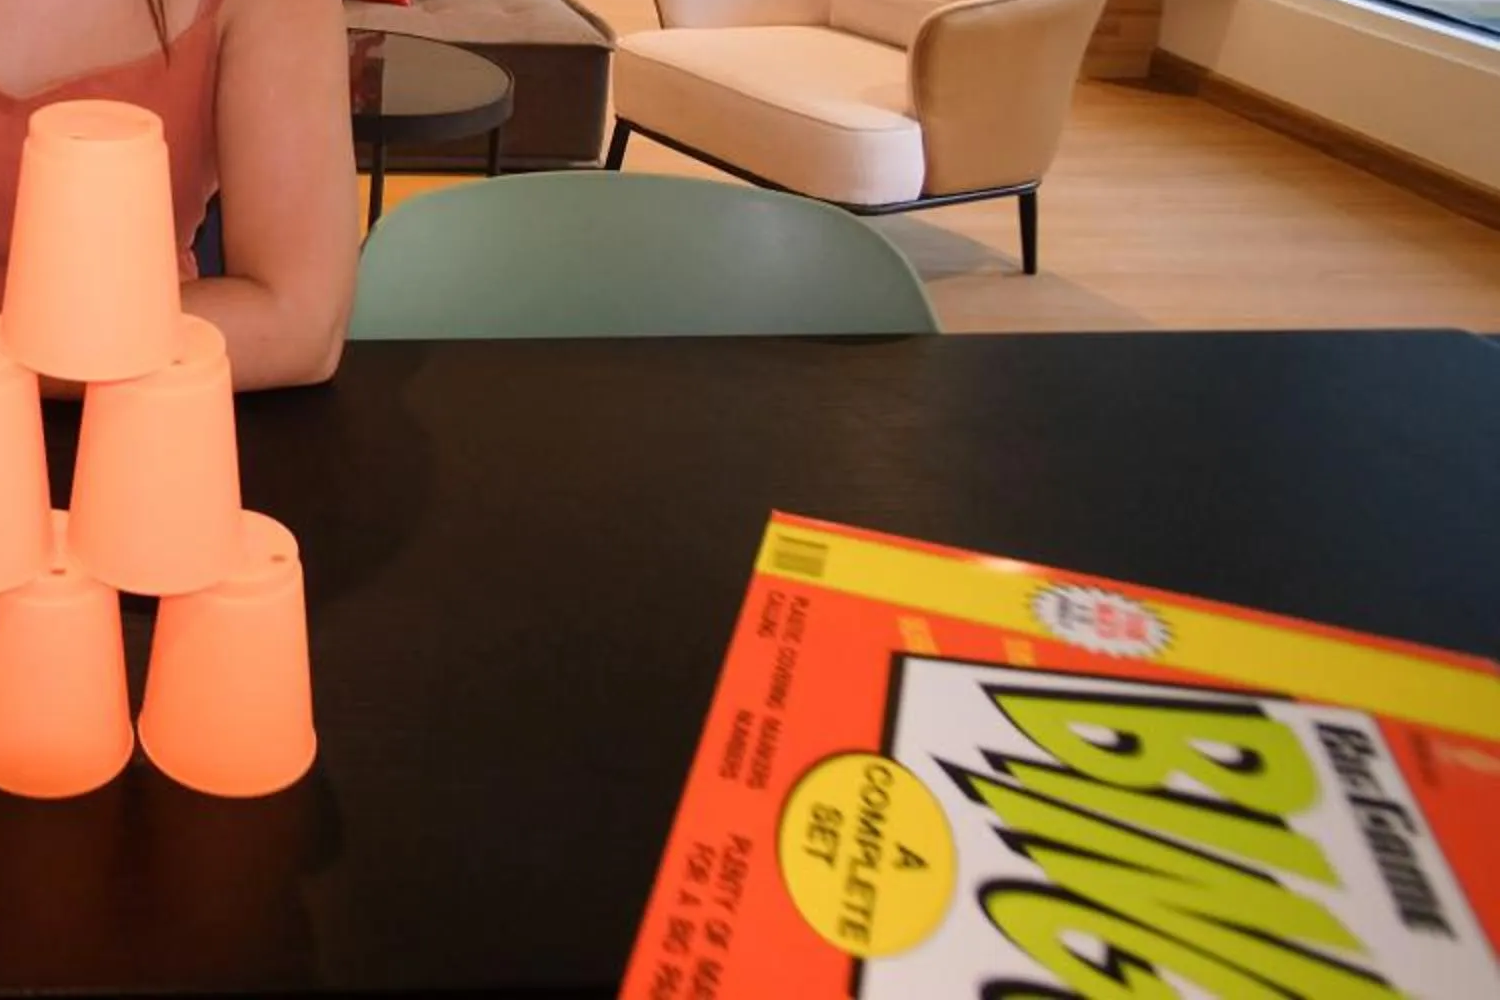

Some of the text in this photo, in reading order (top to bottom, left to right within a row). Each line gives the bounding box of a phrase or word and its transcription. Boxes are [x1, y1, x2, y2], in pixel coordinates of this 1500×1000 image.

[803, 802, 844, 869] SET
[837, 763, 894, 946] COMPLETE
[894, 842, 930, 870] A
[930, 682, 1418, 1000] BING
[686, 840, 716, 884] FOR
[712, 831, 753, 914] PLENTY
[677, 888, 701, 906] A
[662, 914, 695, 954] BIG
[704, 917, 732, 953] OF
